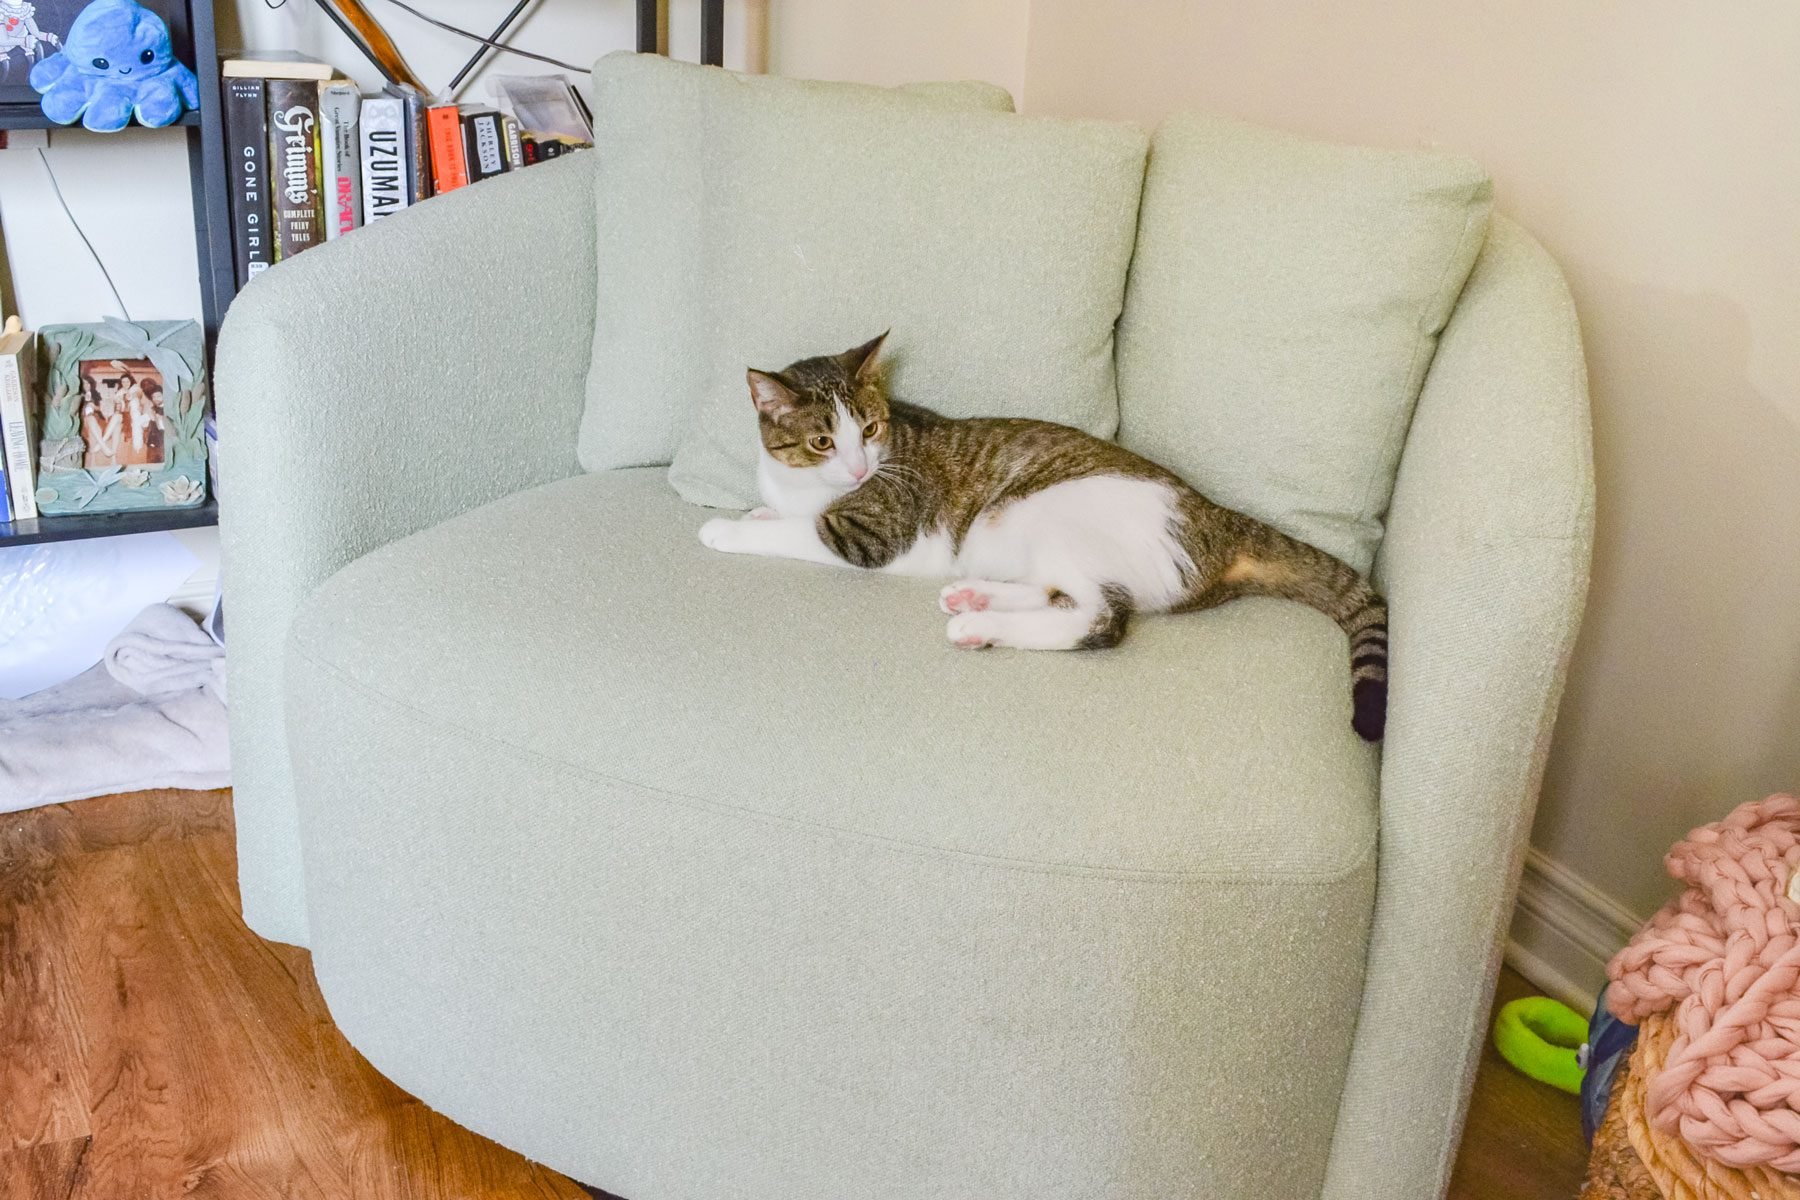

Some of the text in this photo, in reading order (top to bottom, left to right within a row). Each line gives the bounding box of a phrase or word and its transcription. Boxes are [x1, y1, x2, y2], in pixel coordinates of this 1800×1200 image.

[273, 105, 318, 204] Grimm's
[343, 133, 351, 150] Book
[478, 121, 490, 169] JACKSON
[486, 121, 496, 165] SHIRLEY
[507, 123, 521, 166] GARRISON
[243, 146, 258, 202] GONE
[283, 209, 315, 219] COMPLETE
[290, 221, 310, 231] FAIRY
[247, 213, 261, 260] GIRL
[291, 232, 311, 242] TALES
